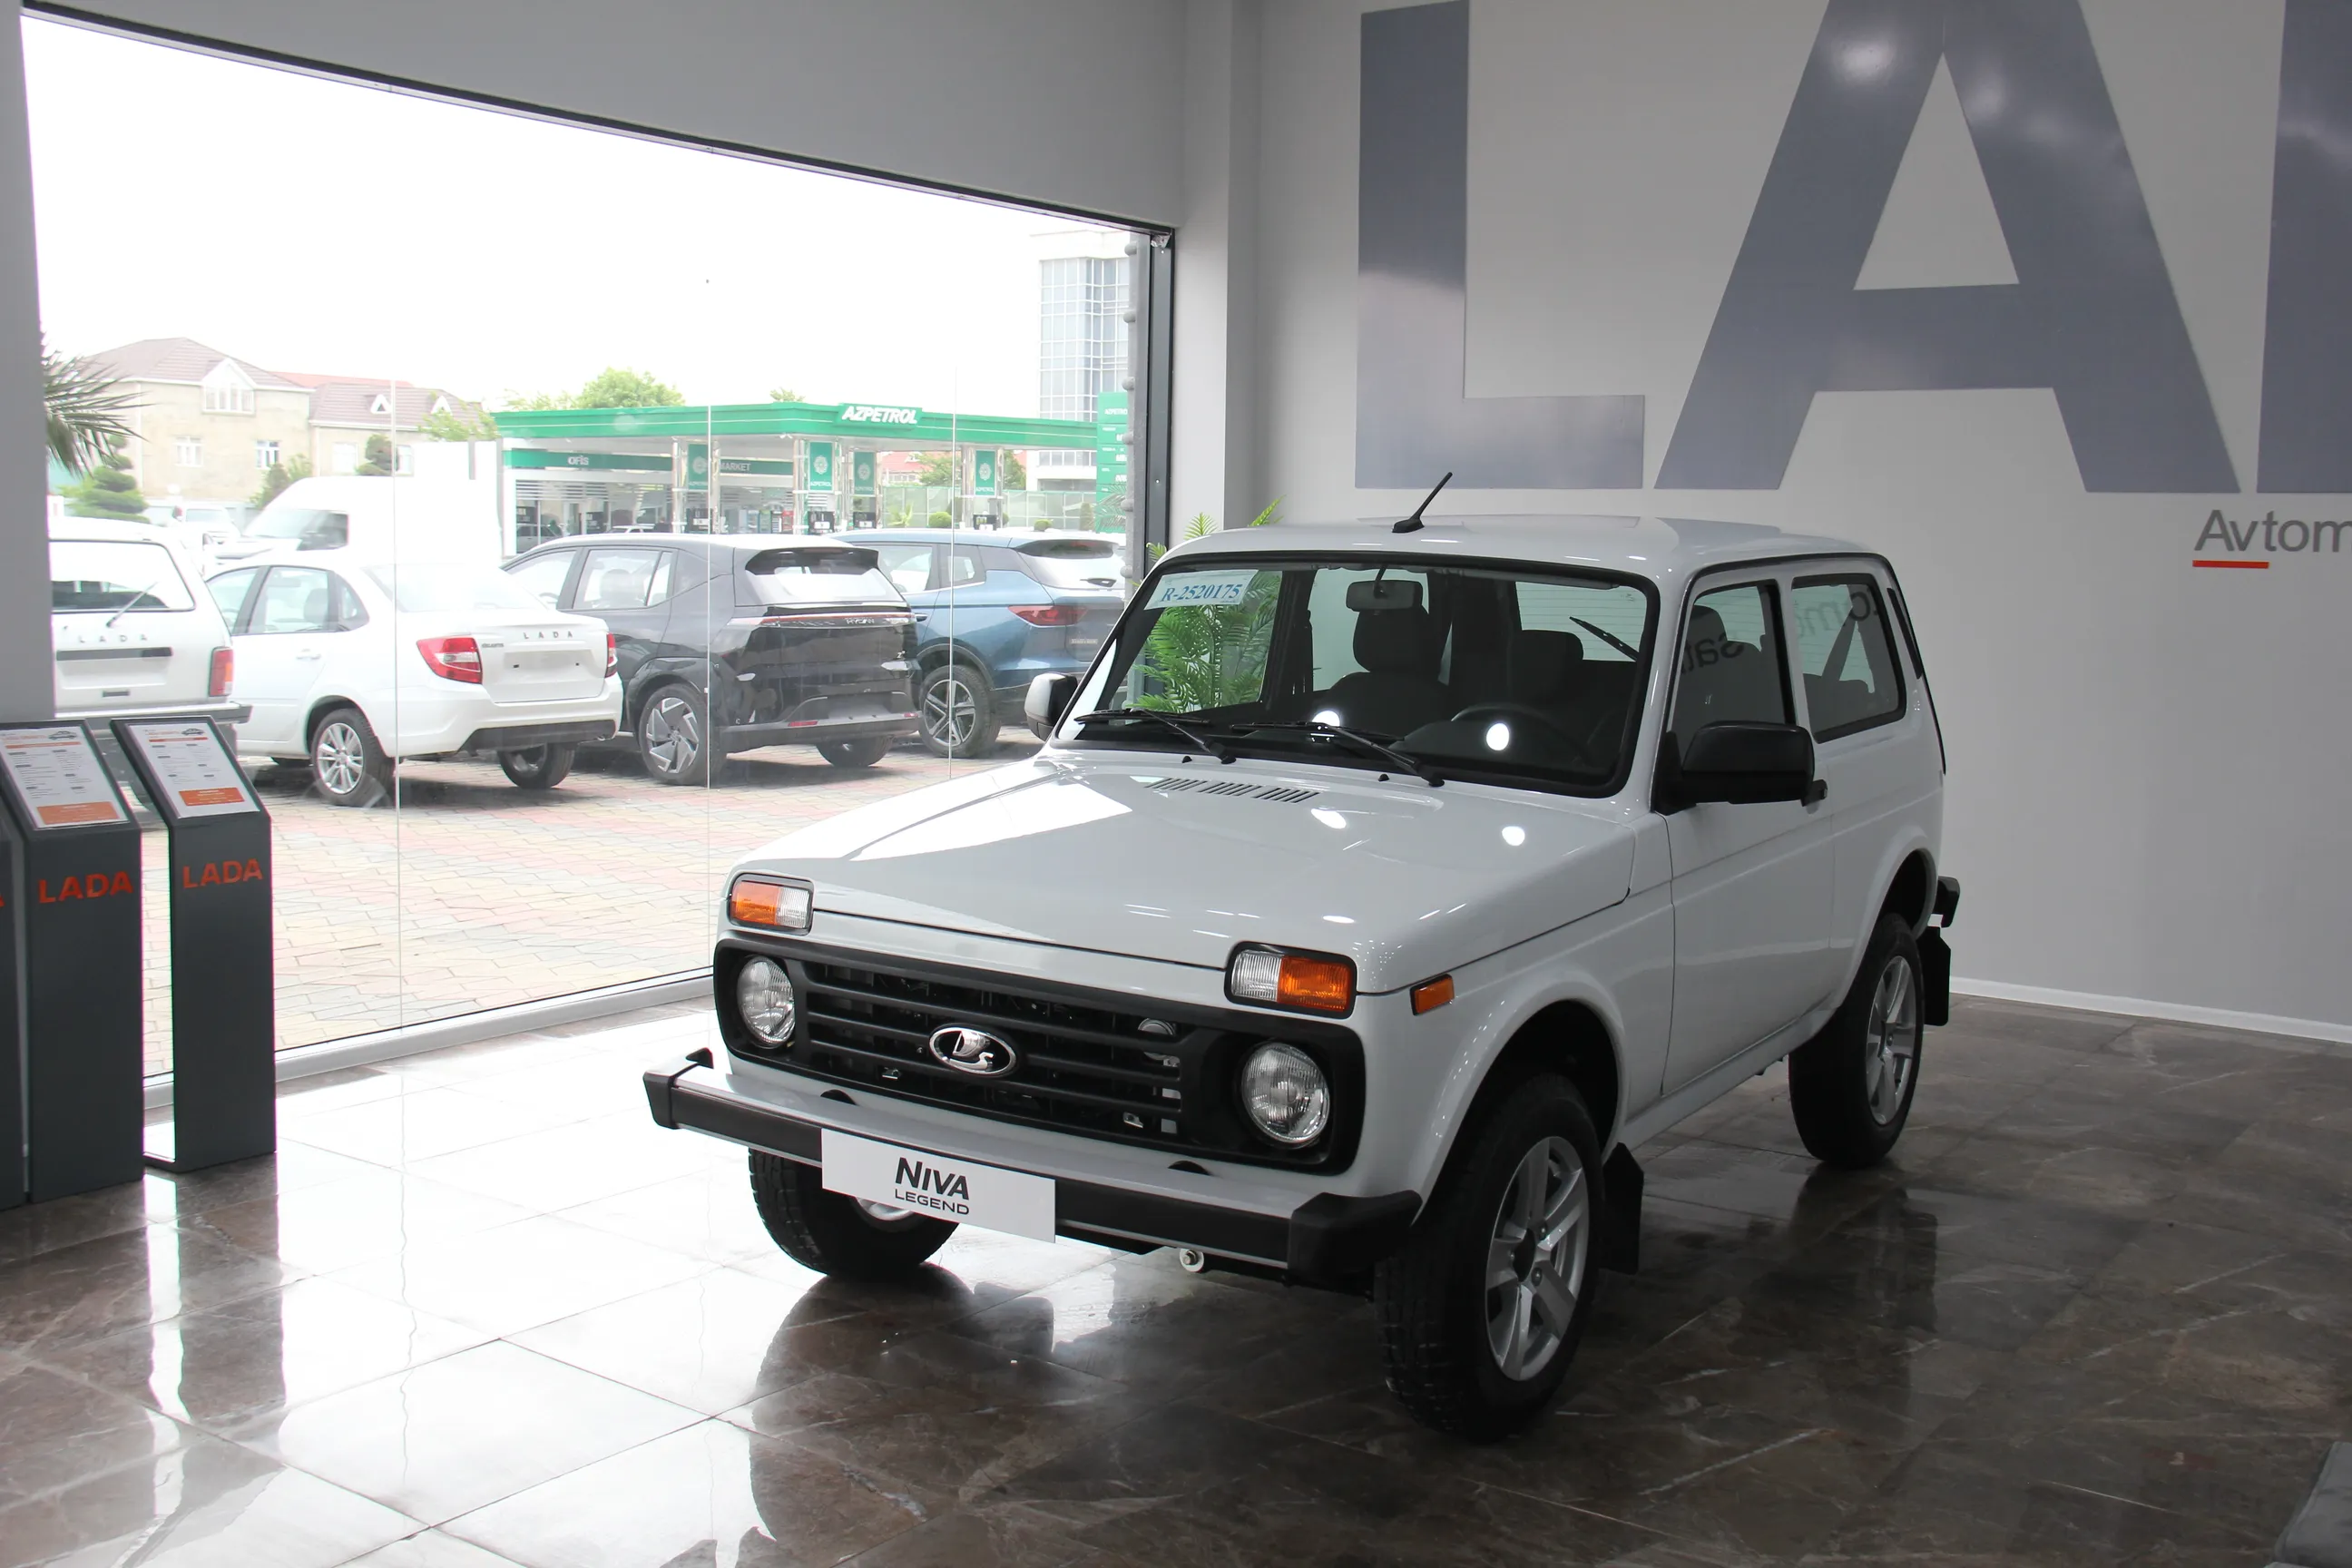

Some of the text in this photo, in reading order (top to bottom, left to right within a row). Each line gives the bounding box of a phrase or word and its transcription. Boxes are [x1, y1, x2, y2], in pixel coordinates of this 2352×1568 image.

[1356, 0, 2352, 493] LA
[841, 406, 918, 425] AZPETROL
[1161, 583, 1243, 602] R-2520175
[78, 633, 148, 643] LADA
[523, 631, 573, 640] LADA
[182, 858, 264, 888] LADA
[38, 870, 133, 904] LADA
[895, 1156, 970, 1200] NIVA
[895, 1188, 970, 1215] LEGEND
